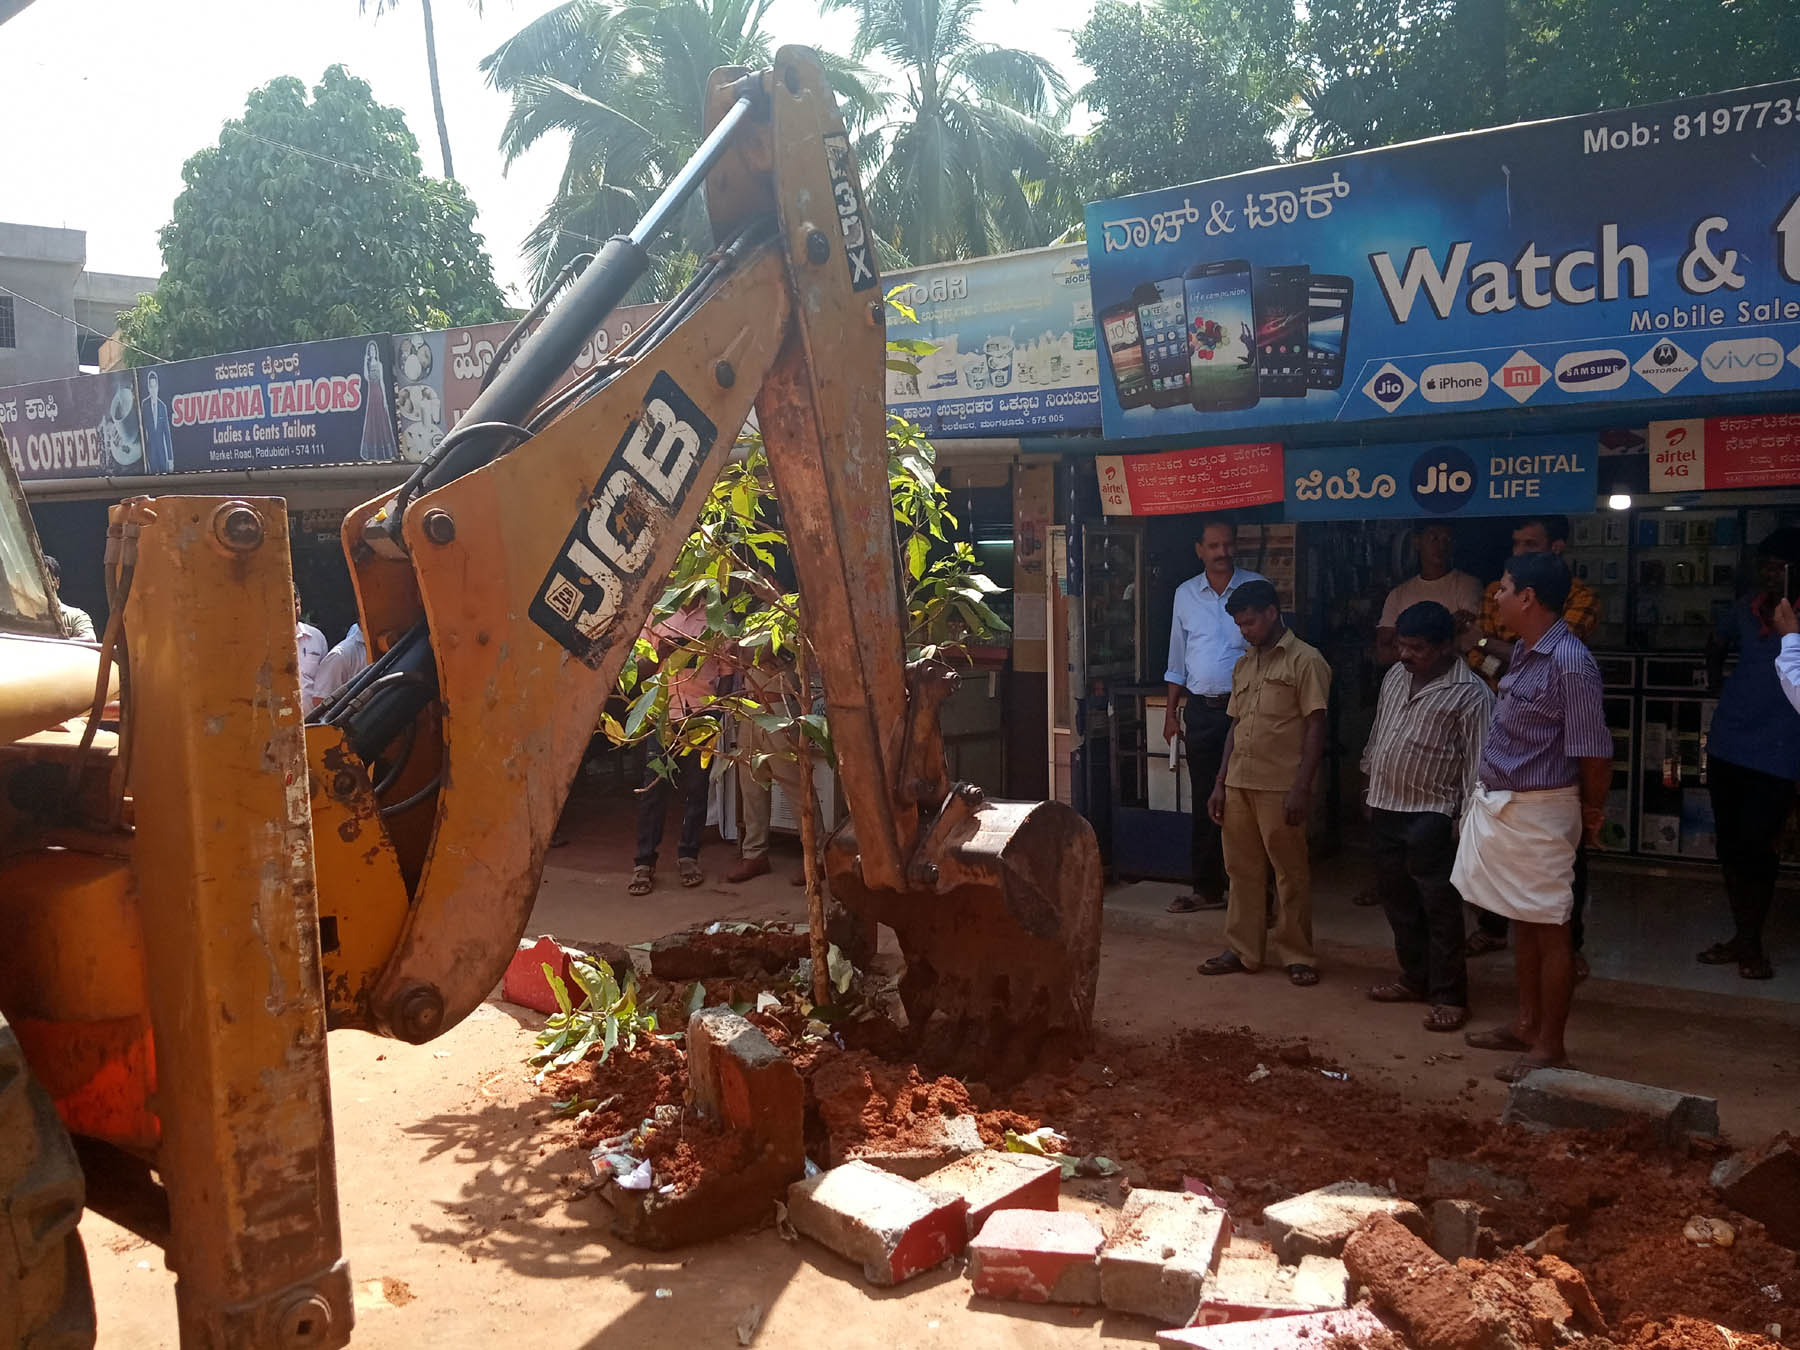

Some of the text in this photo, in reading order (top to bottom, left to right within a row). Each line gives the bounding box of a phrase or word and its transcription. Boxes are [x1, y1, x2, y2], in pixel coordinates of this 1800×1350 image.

[1583, 96, 1800, 154] Mob: 819773
[1103, 172, 1350, 253] ವಾಚ್ & ಟಾಕ್
[1369, 223, 1650, 324] Watch
[1681, 216, 1746, 294] &
[1630, 304, 1725, 332] Mobile
[1566, 364, 1620, 377] SAMSUNG
[1641, 366, 1689, 375] MOTOROLA
[1378, 382, 1402, 395] Jio
[1439, 377, 1482, 390] iPhone
[173, 377, 361, 426] SUVARNA TAILORS
[213, 419, 316, 444] Ladies & Gents Tailors
[27, 427, 100, 471] COFFEE
[209, 447, 233, 461] Market
[234, 447, 254, 461] Road,
[1655, 449, 1697, 463] airtel
[1490, 454, 1585, 477] DIGITAL
[1664, 464, 1689, 477] 4G
[1102, 483, 1125, 494] airtel
[1417, 462, 1472, 494] Jio
[1489, 479, 1540, 499] LIFE
[1109, 495, 1122, 505] 4G
[567, 398, 701, 640] JCB
[553, 586, 576, 614] JCB
